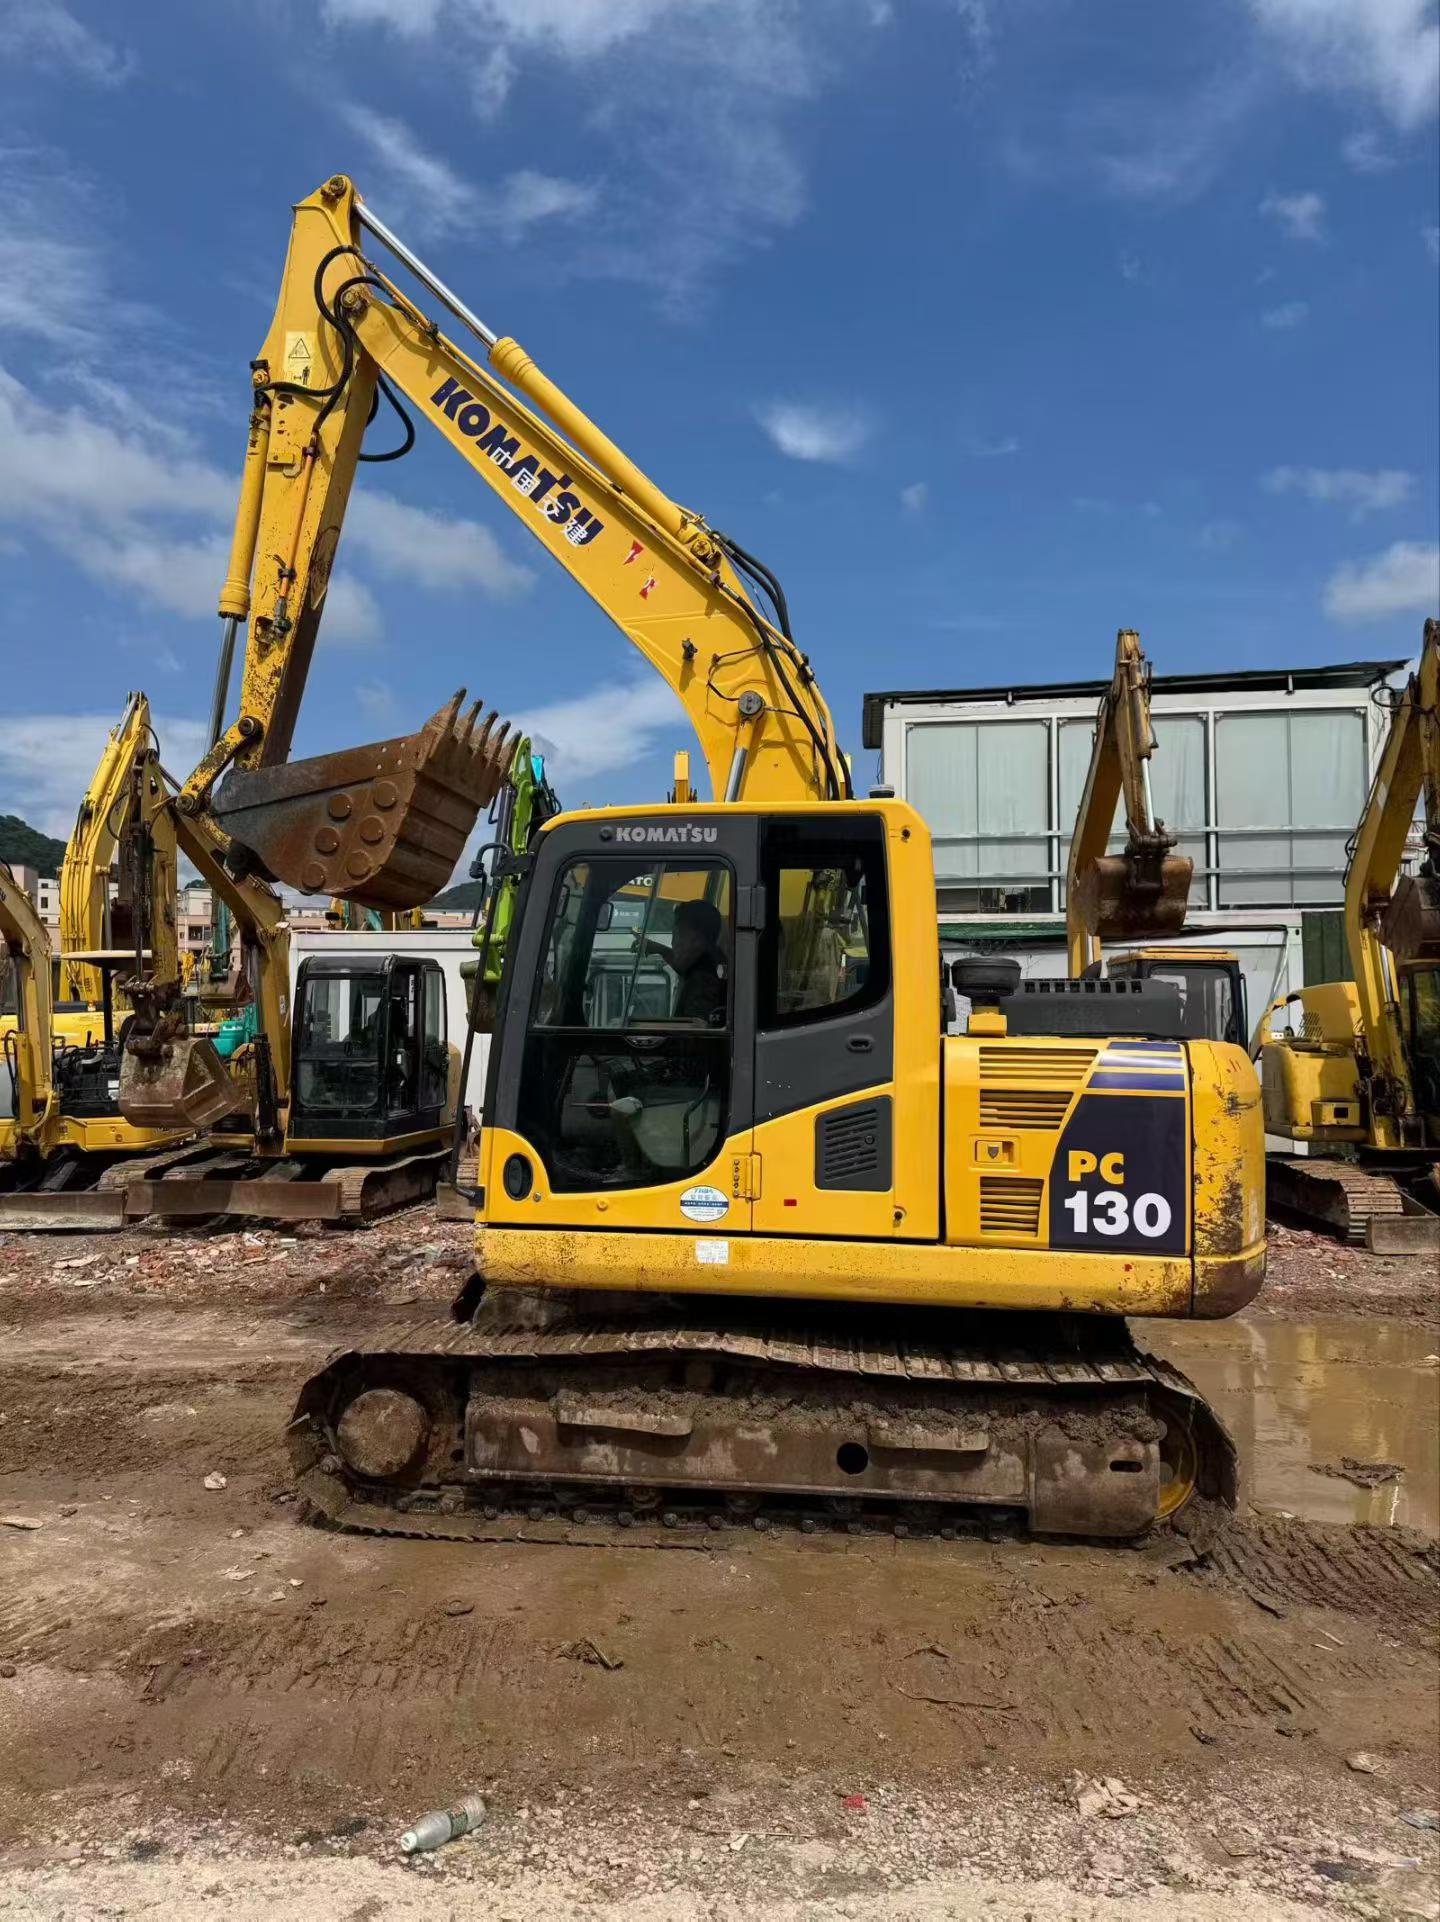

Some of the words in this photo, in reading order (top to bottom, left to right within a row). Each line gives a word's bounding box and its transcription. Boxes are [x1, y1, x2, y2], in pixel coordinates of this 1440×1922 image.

[430, 376, 605, 546] KOMATSU
[616, 823, 718, 843] KOMATSU
[1068, 1150, 1124, 1185] PC
[1064, 1190, 1172, 1238] 130
